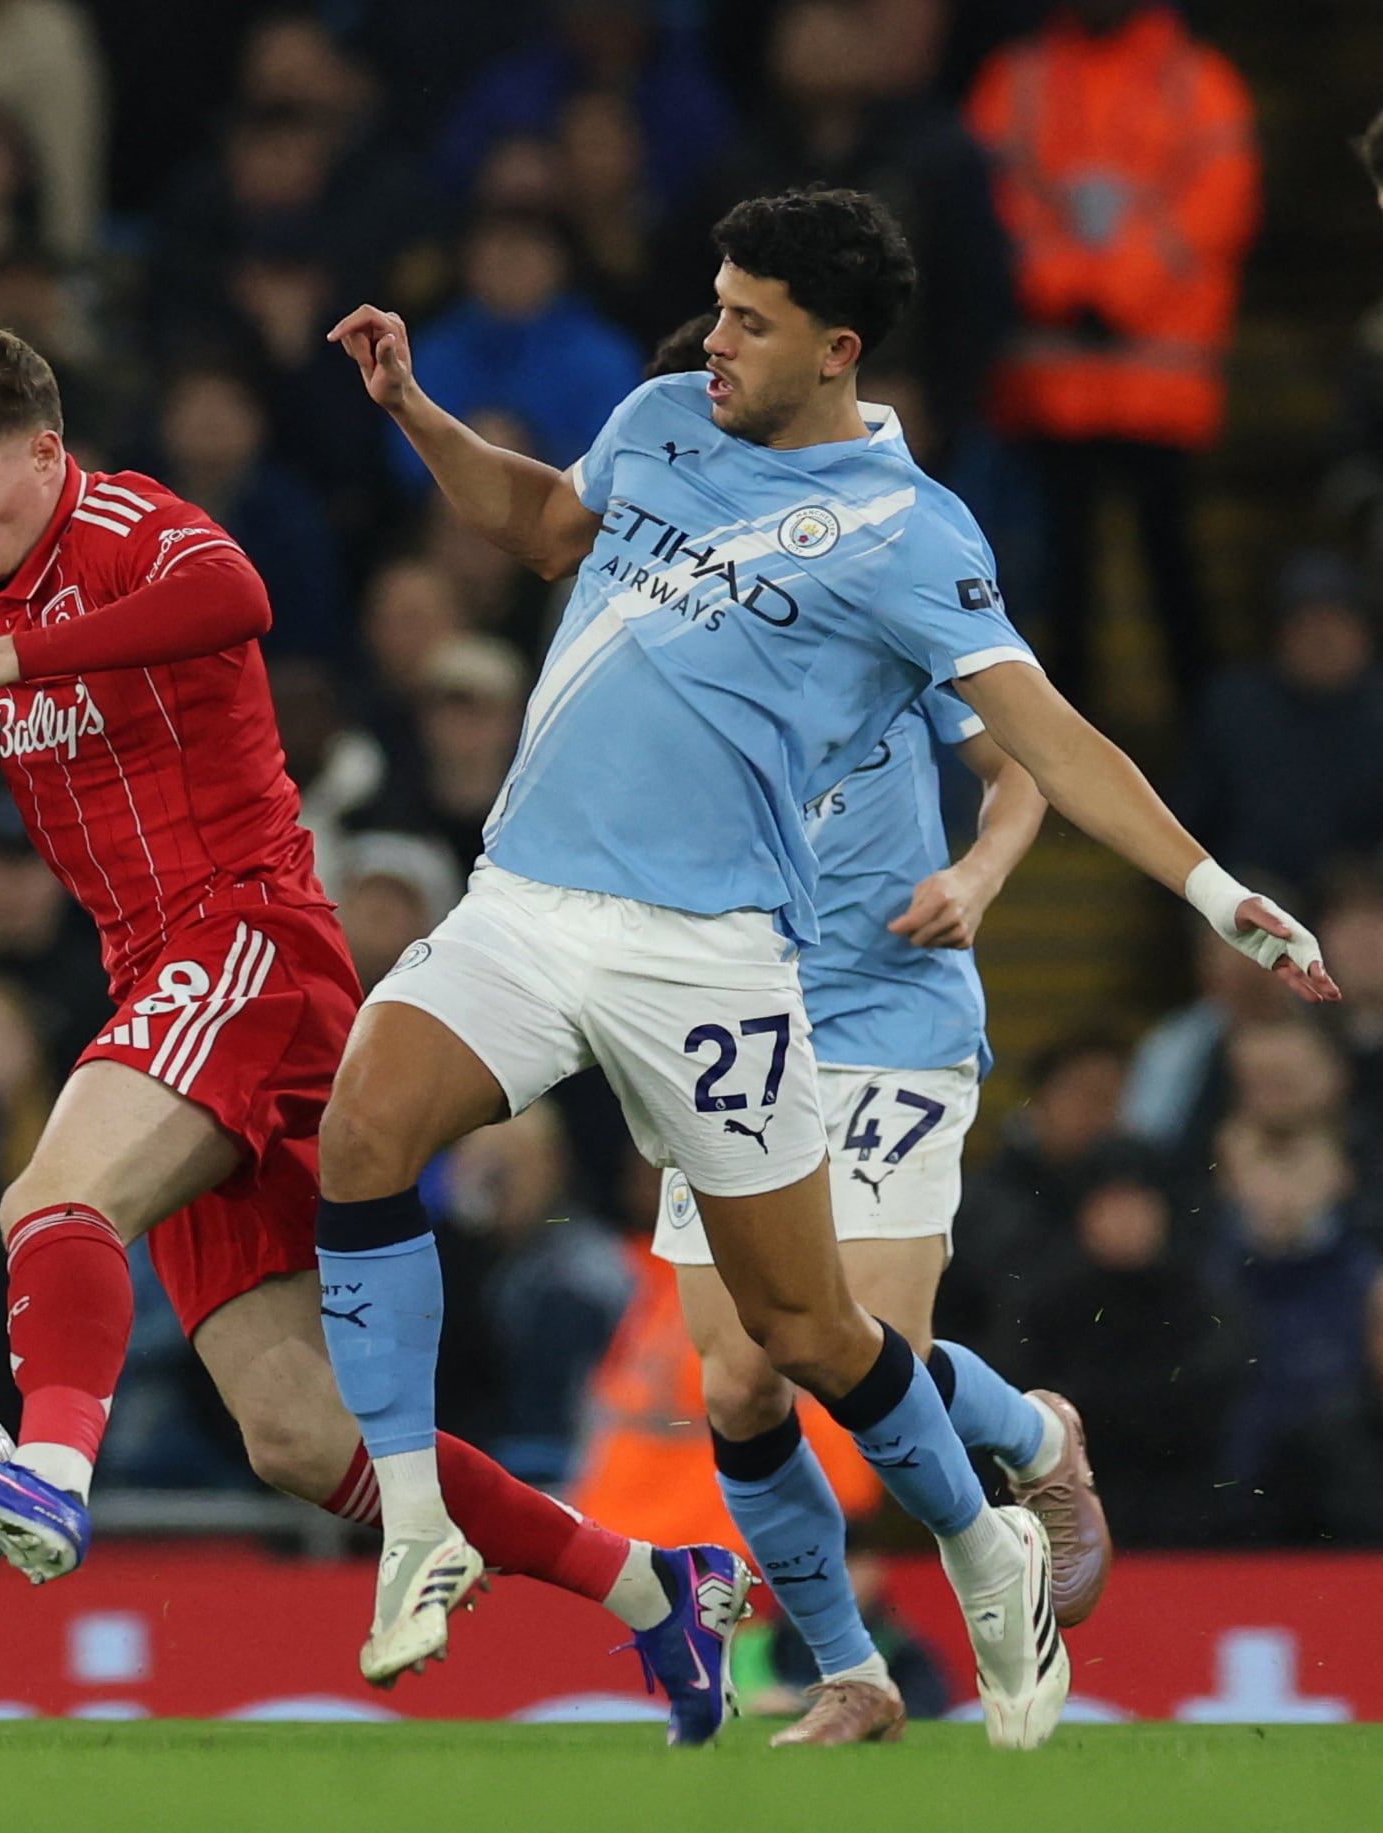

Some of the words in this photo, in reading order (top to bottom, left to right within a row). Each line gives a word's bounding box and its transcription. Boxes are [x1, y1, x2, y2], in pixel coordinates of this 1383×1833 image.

[599, 555, 726, 632] AIRWAYS
[601, 496, 799, 627] ETIHAD
[133, 960, 210, 1015] 8
[683, 1013, 790, 1113] 27
[843, 1086, 947, 1164] 47
